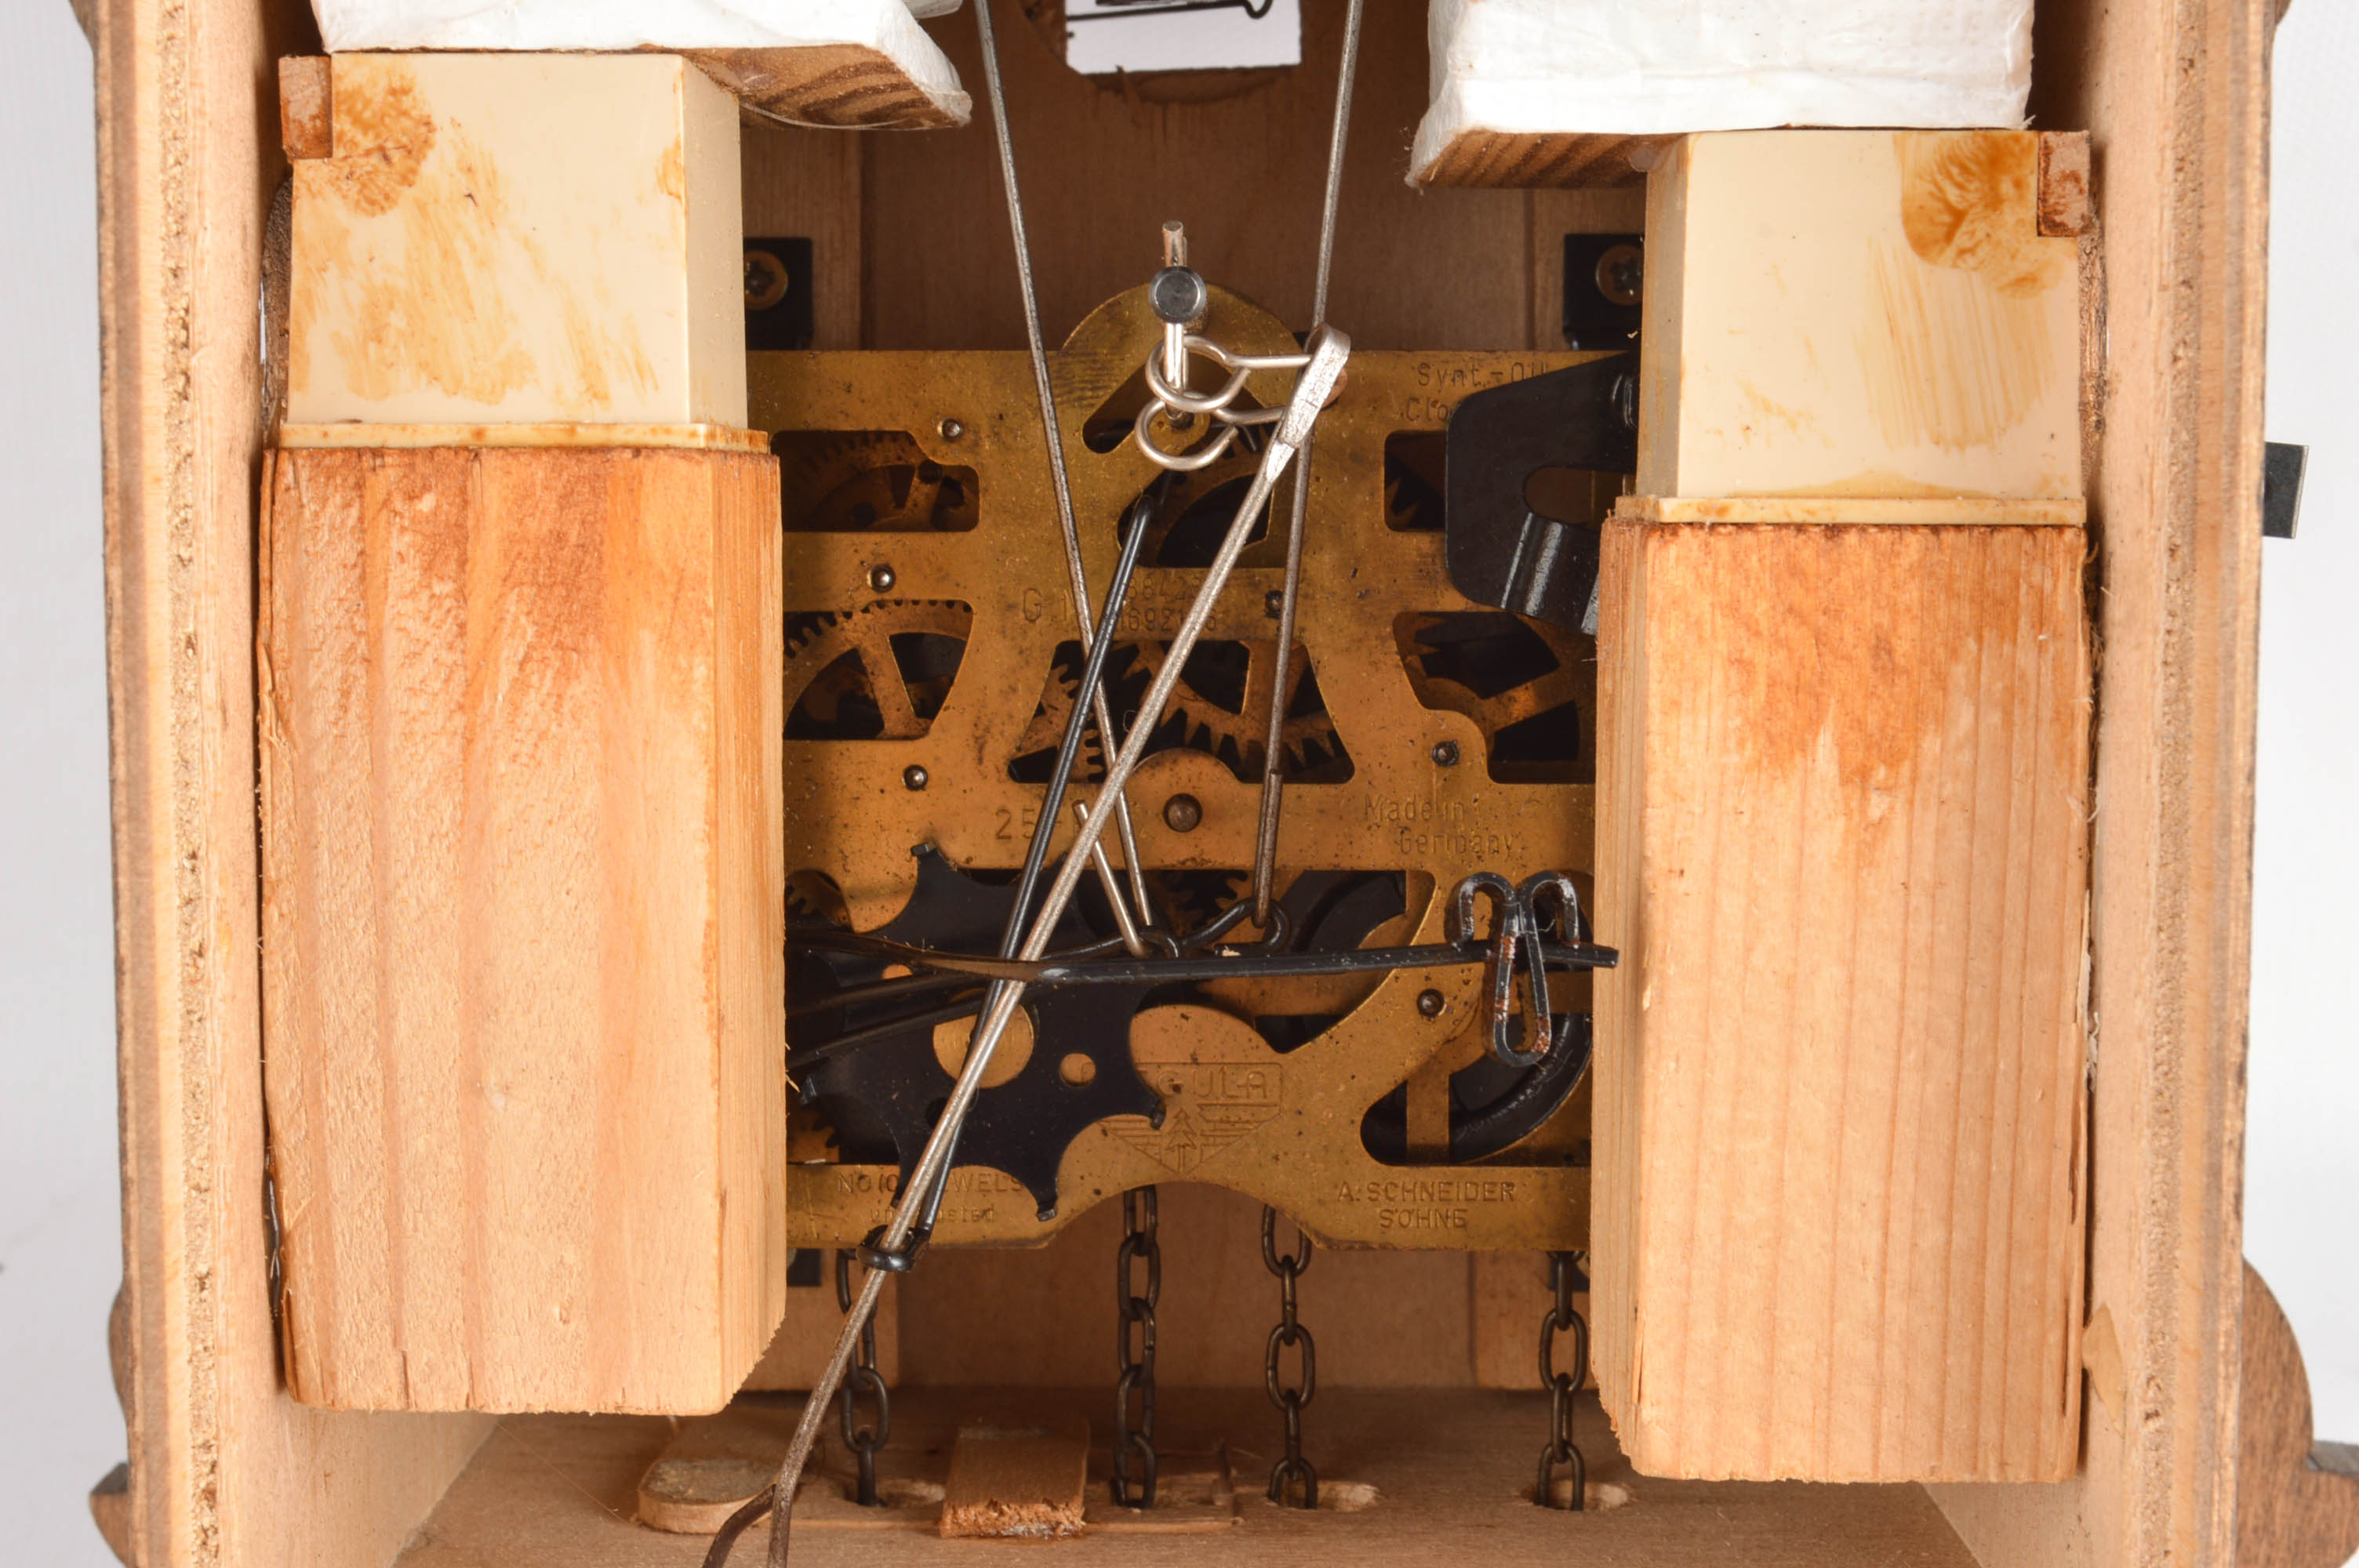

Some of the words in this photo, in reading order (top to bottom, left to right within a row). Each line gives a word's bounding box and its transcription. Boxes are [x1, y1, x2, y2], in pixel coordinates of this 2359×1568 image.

[1405, 397, 1449, 421] Clo
[1364, 793, 1432, 821] Made
[1443, 798, 1465, 822] in
[1398, 826, 1513, 859] Germany
[1137, 1069, 1267, 1098] GULA
[1366, 1181, 1516, 1203] SCHNEIDER
